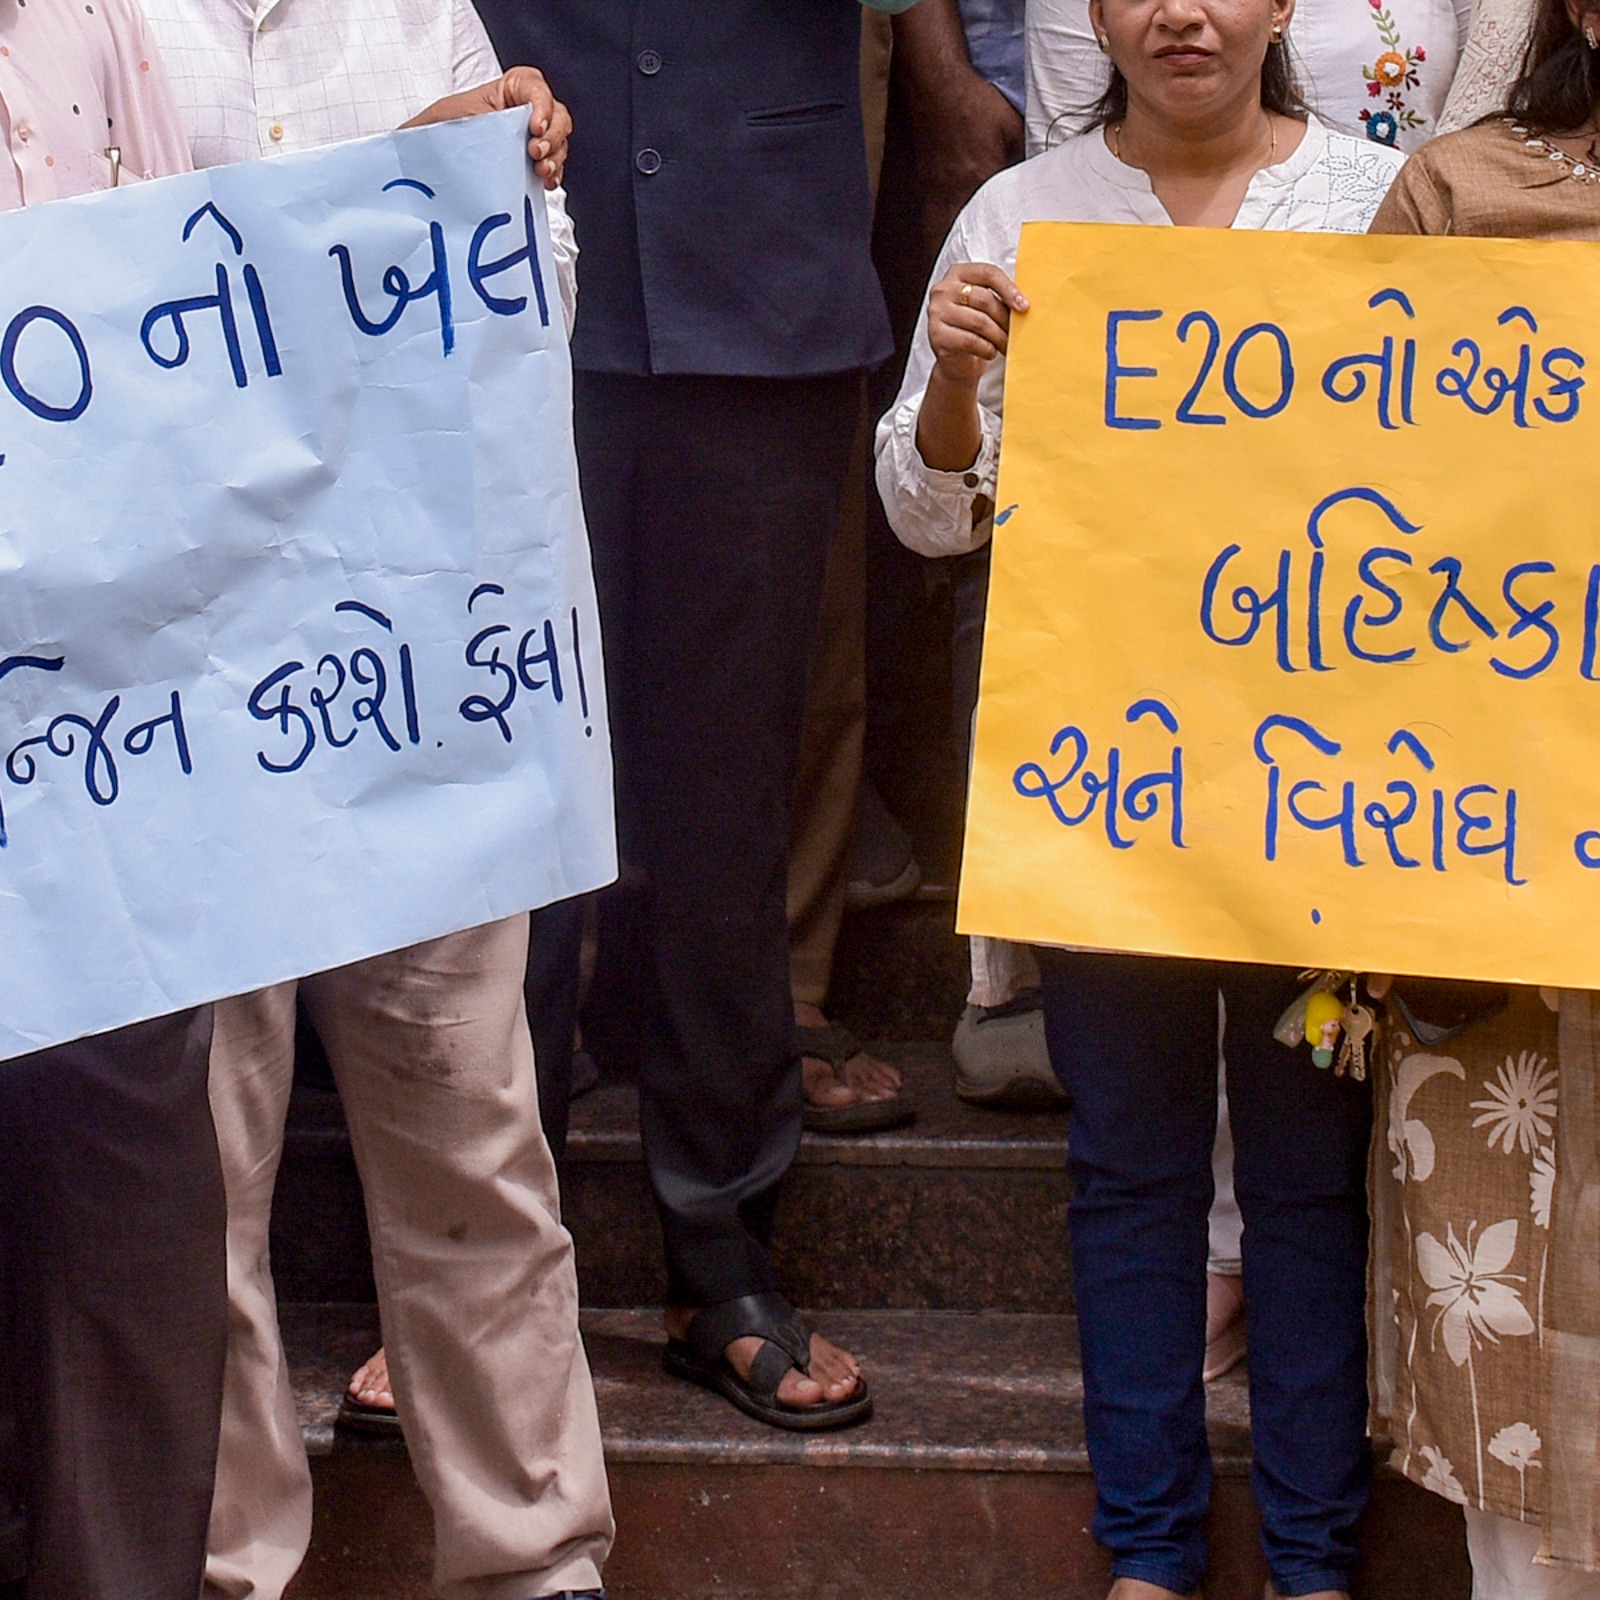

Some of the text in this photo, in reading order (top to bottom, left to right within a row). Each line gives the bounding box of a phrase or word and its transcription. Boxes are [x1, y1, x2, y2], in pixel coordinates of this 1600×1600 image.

[140, 201, 282, 388] નો
[328, 170, 552, 357] ખેલ
[1105, 310, 1295, 430] E20
[1322, 288, 1417, 430] નો
[1436, 306, 1585, 428] એક
[1013, 699, 1188, 849] અને
